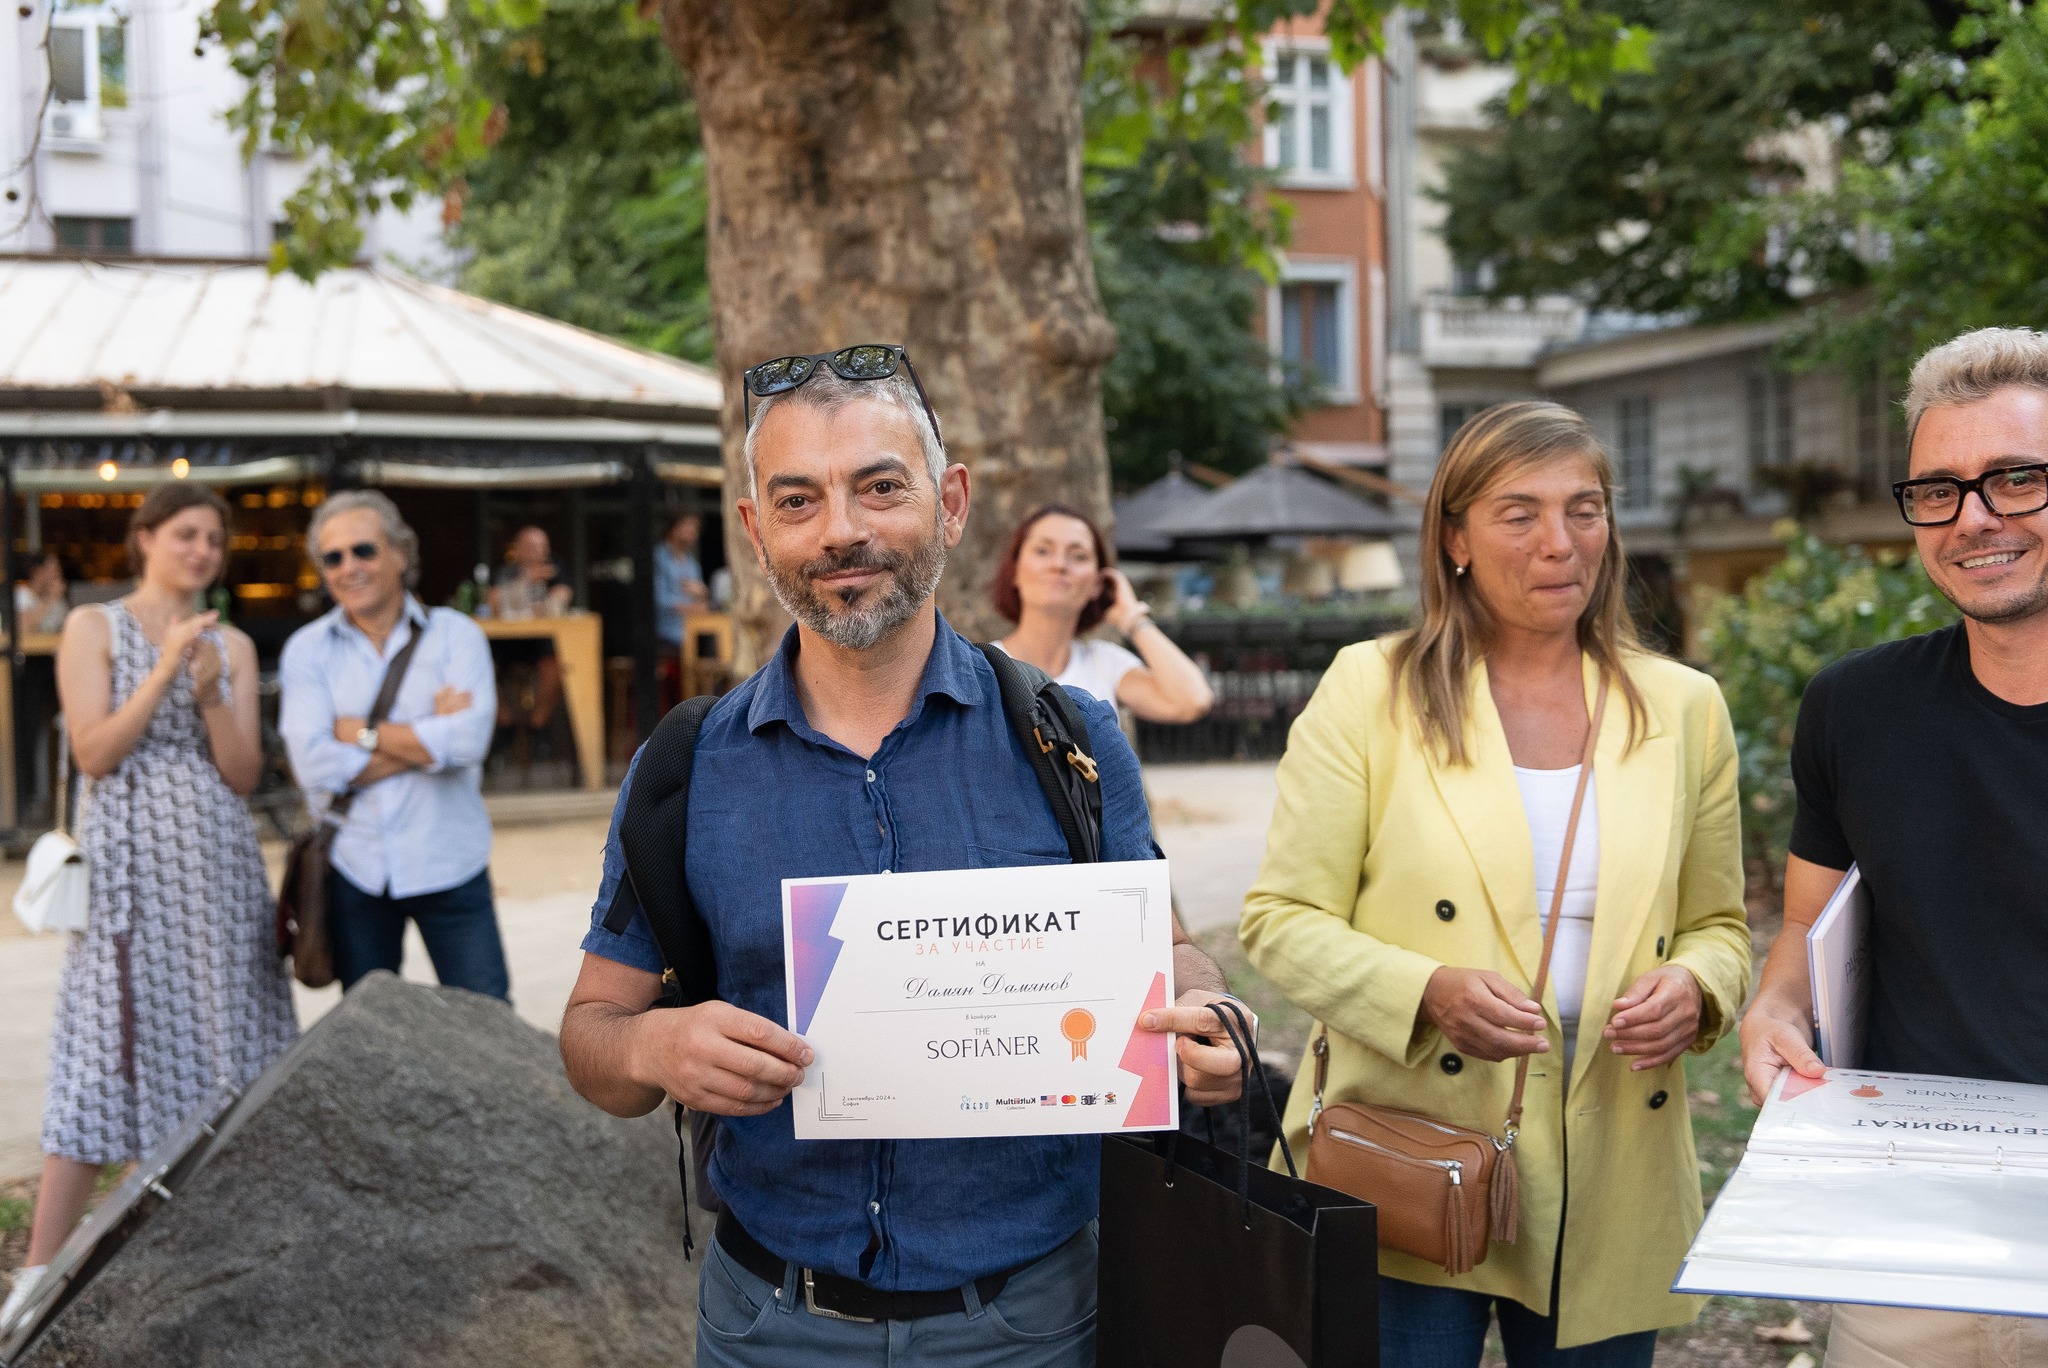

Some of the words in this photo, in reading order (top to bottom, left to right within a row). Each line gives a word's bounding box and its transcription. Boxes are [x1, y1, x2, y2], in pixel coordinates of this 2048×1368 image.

[877, 910, 1080, 941] СЕРТИФИКАТ
[916, 943, 939, 955] ЗА
[952, 937, 1044, 953] УЧАСТИЕ
[903, 976, 975, 999] Дамян
[979, 972, 1072, 995] Дамянов
[974, 1027, 990, 1036] THE
[927, 1035, 1040, 1060] SOFIANER
